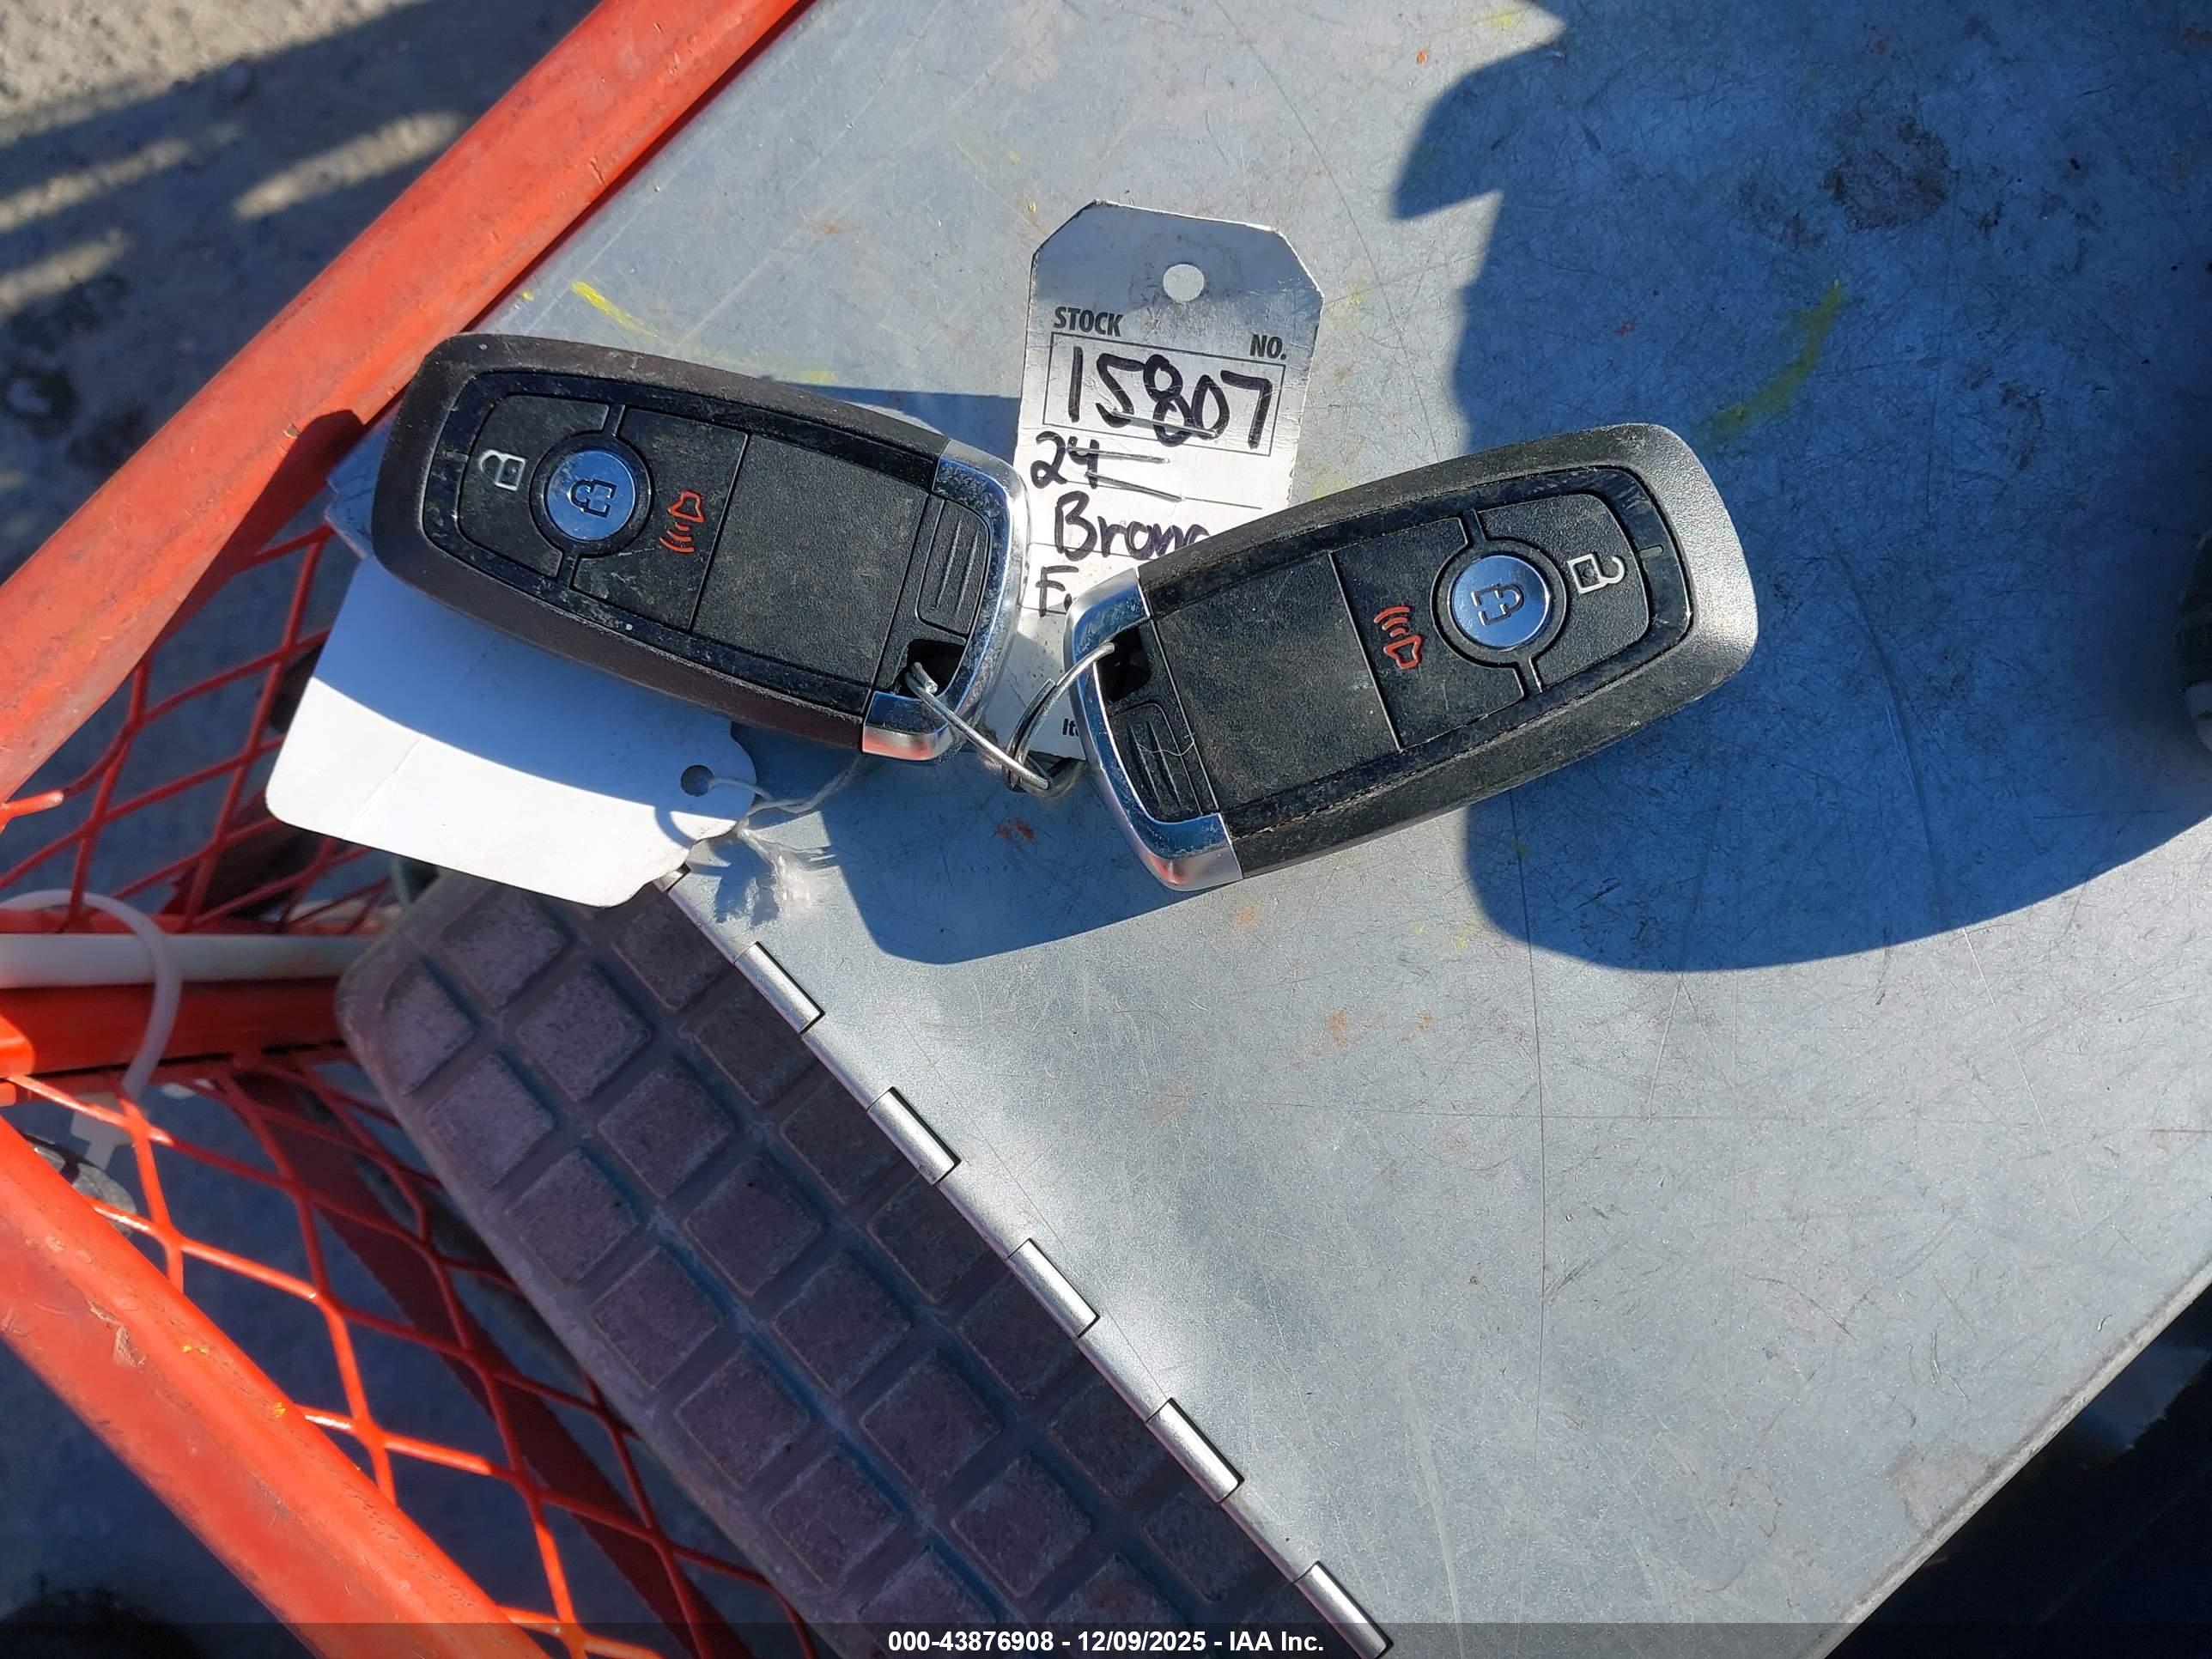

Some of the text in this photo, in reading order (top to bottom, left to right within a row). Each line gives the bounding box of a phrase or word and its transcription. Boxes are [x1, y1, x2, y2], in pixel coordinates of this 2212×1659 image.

[1053, 306, 1287, 360] STOCK NO.
[1067, 345, 1273, 450] 15807
[1030, 430, 1100, 490] 24
